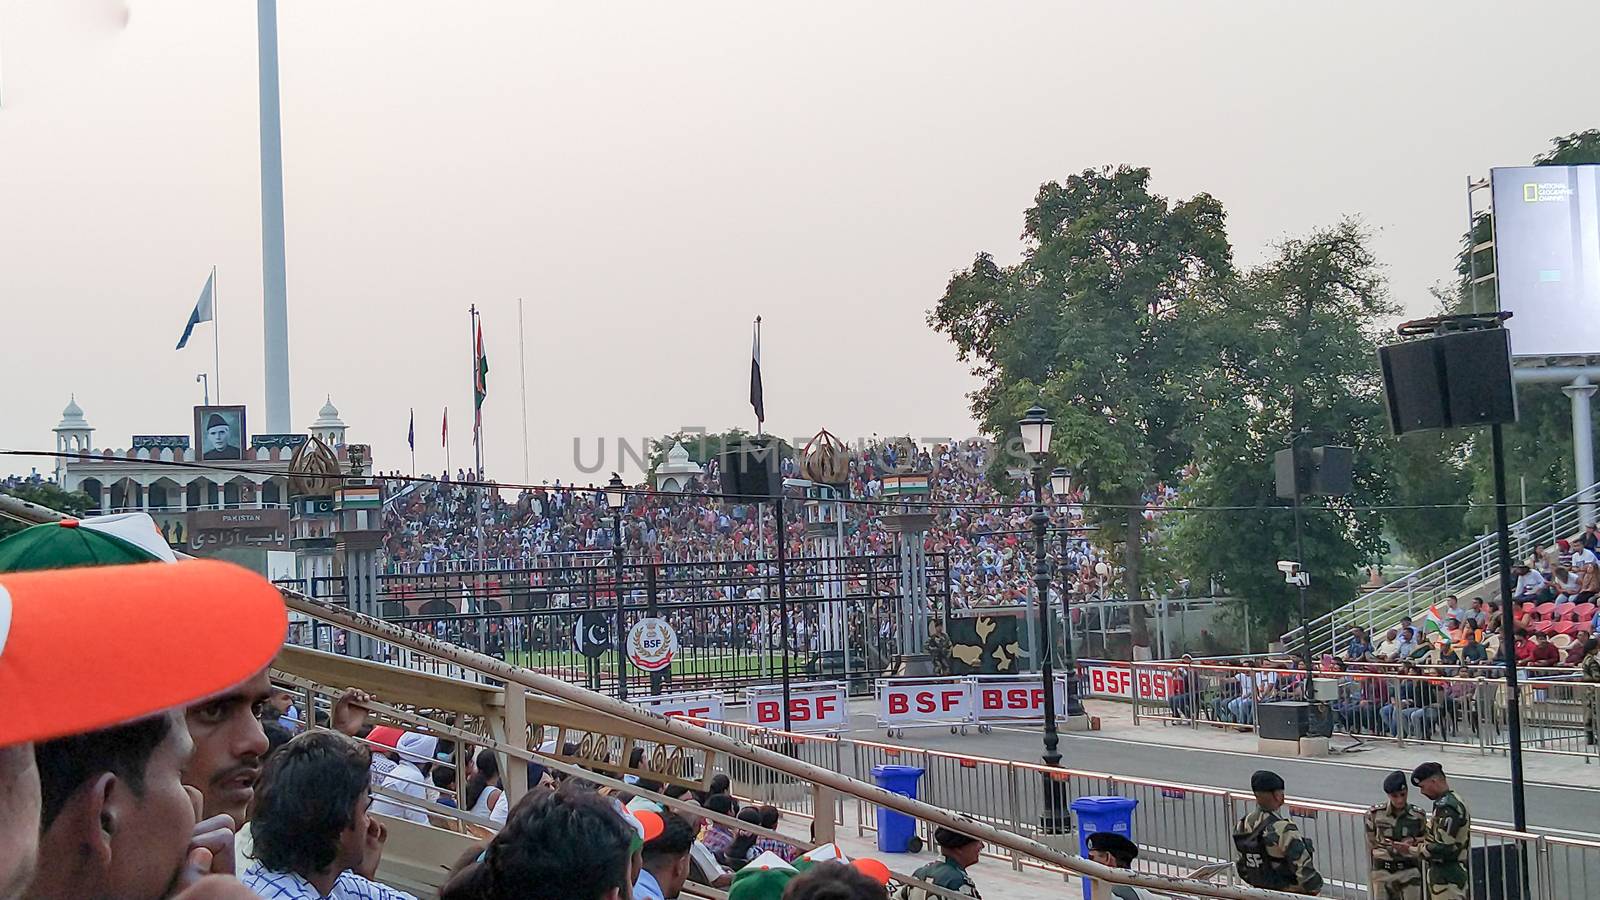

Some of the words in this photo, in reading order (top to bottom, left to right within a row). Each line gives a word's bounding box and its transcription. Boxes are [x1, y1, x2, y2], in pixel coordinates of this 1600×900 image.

[643, 639, 661, 649] BSF
[1092, 669, 1131, 694] BSF
[1138, 672, 1167, 698] BS
[756, 695, 838, 723] BSF
[888, 690, 964, 715] BSF
[1245, 853, 1263, 868] SF
